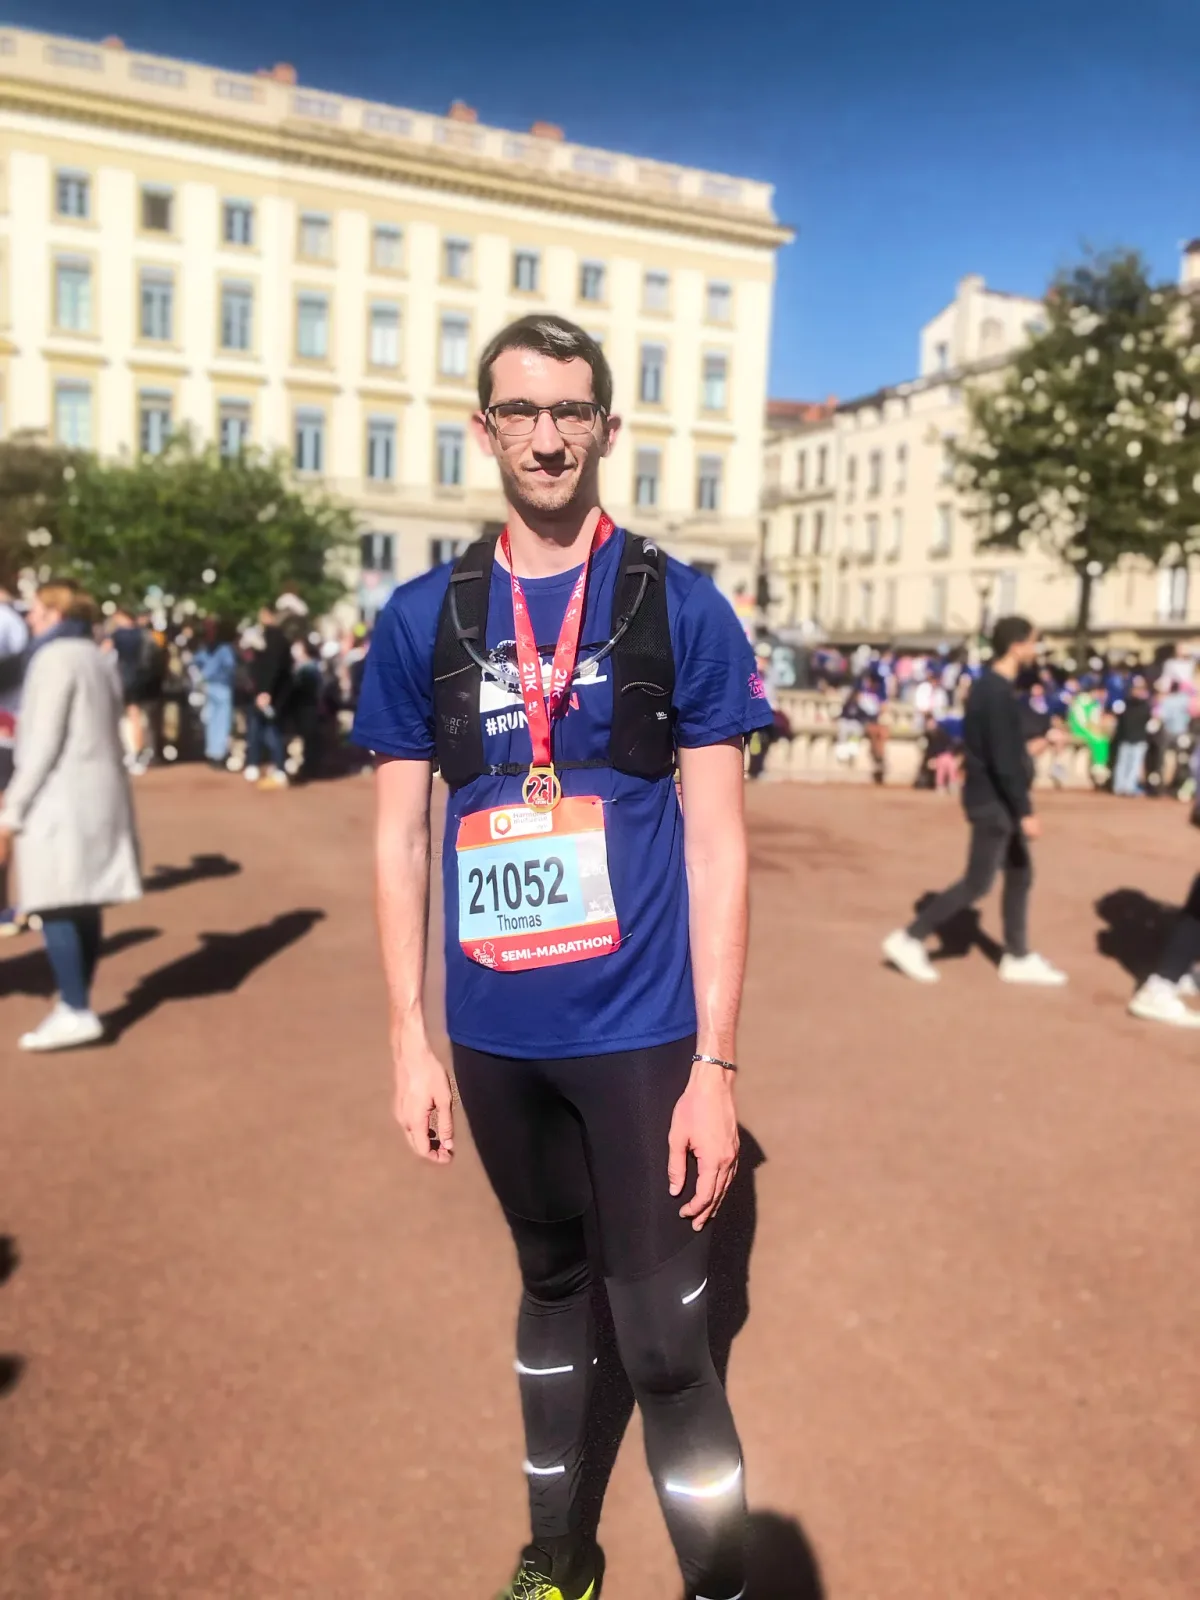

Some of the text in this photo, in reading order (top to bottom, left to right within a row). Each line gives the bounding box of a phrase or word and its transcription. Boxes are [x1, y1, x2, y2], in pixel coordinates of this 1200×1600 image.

[571, 572, 585, 600] 21K
[522, 662, 538, 692] 21K
[552, 669, 568, 699] 21K
[527, 776, 554, 804] 21
[468, 856, 569, 915] 21052
[497, 914, 542, 932] Thomas
[501, 935, 613, 962] SEMI-MARATHON
